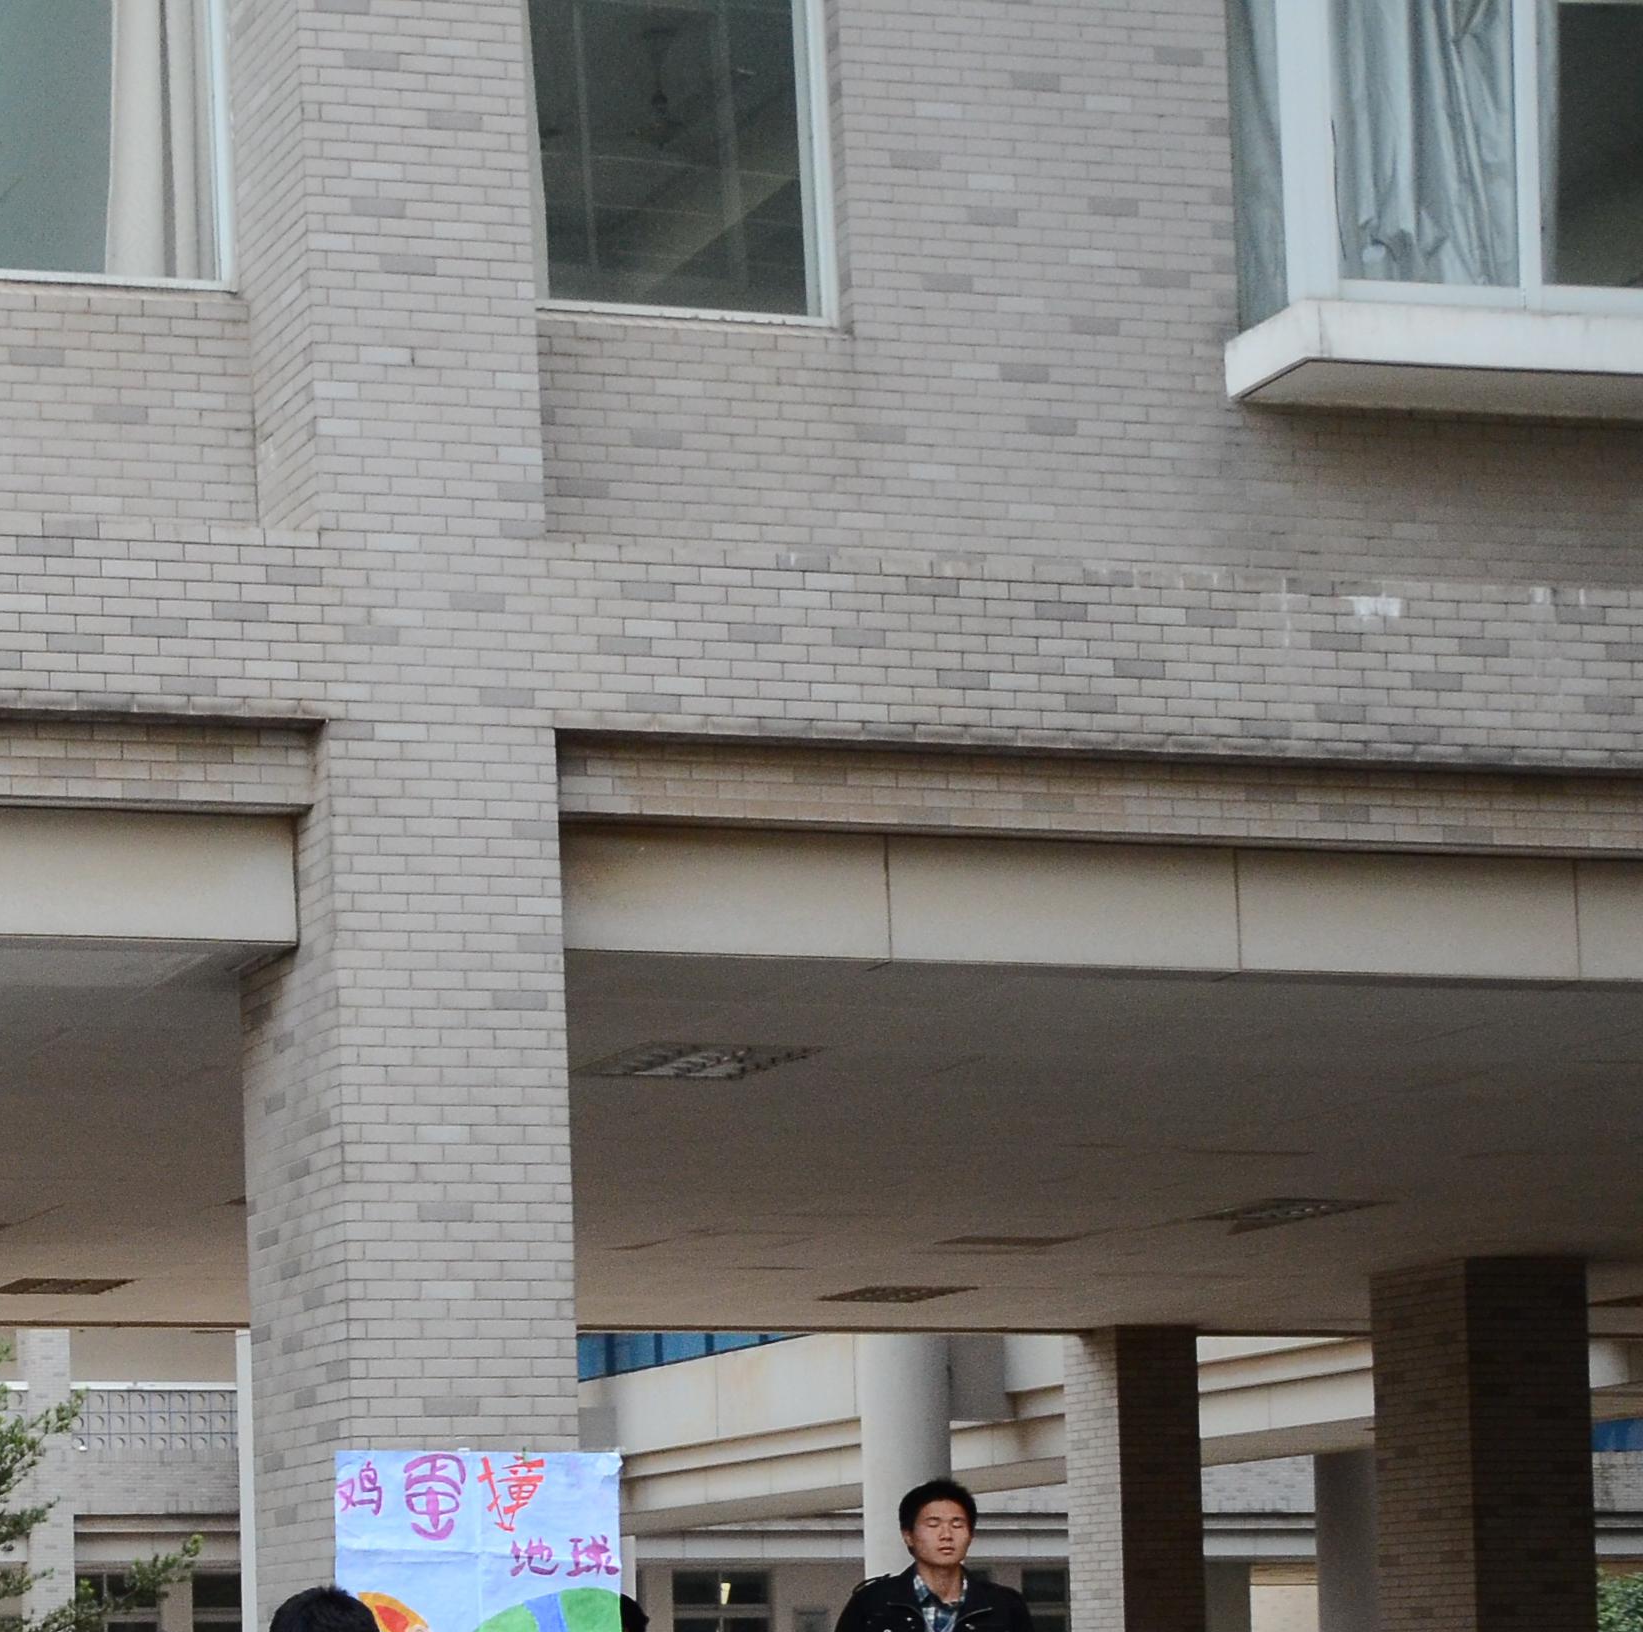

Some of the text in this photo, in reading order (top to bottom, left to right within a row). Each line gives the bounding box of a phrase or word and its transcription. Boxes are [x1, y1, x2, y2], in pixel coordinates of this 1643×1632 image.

[336, 1453, 547, 1541] 鸡蛋撞
[509, 1534, 620, 1578] 地球
